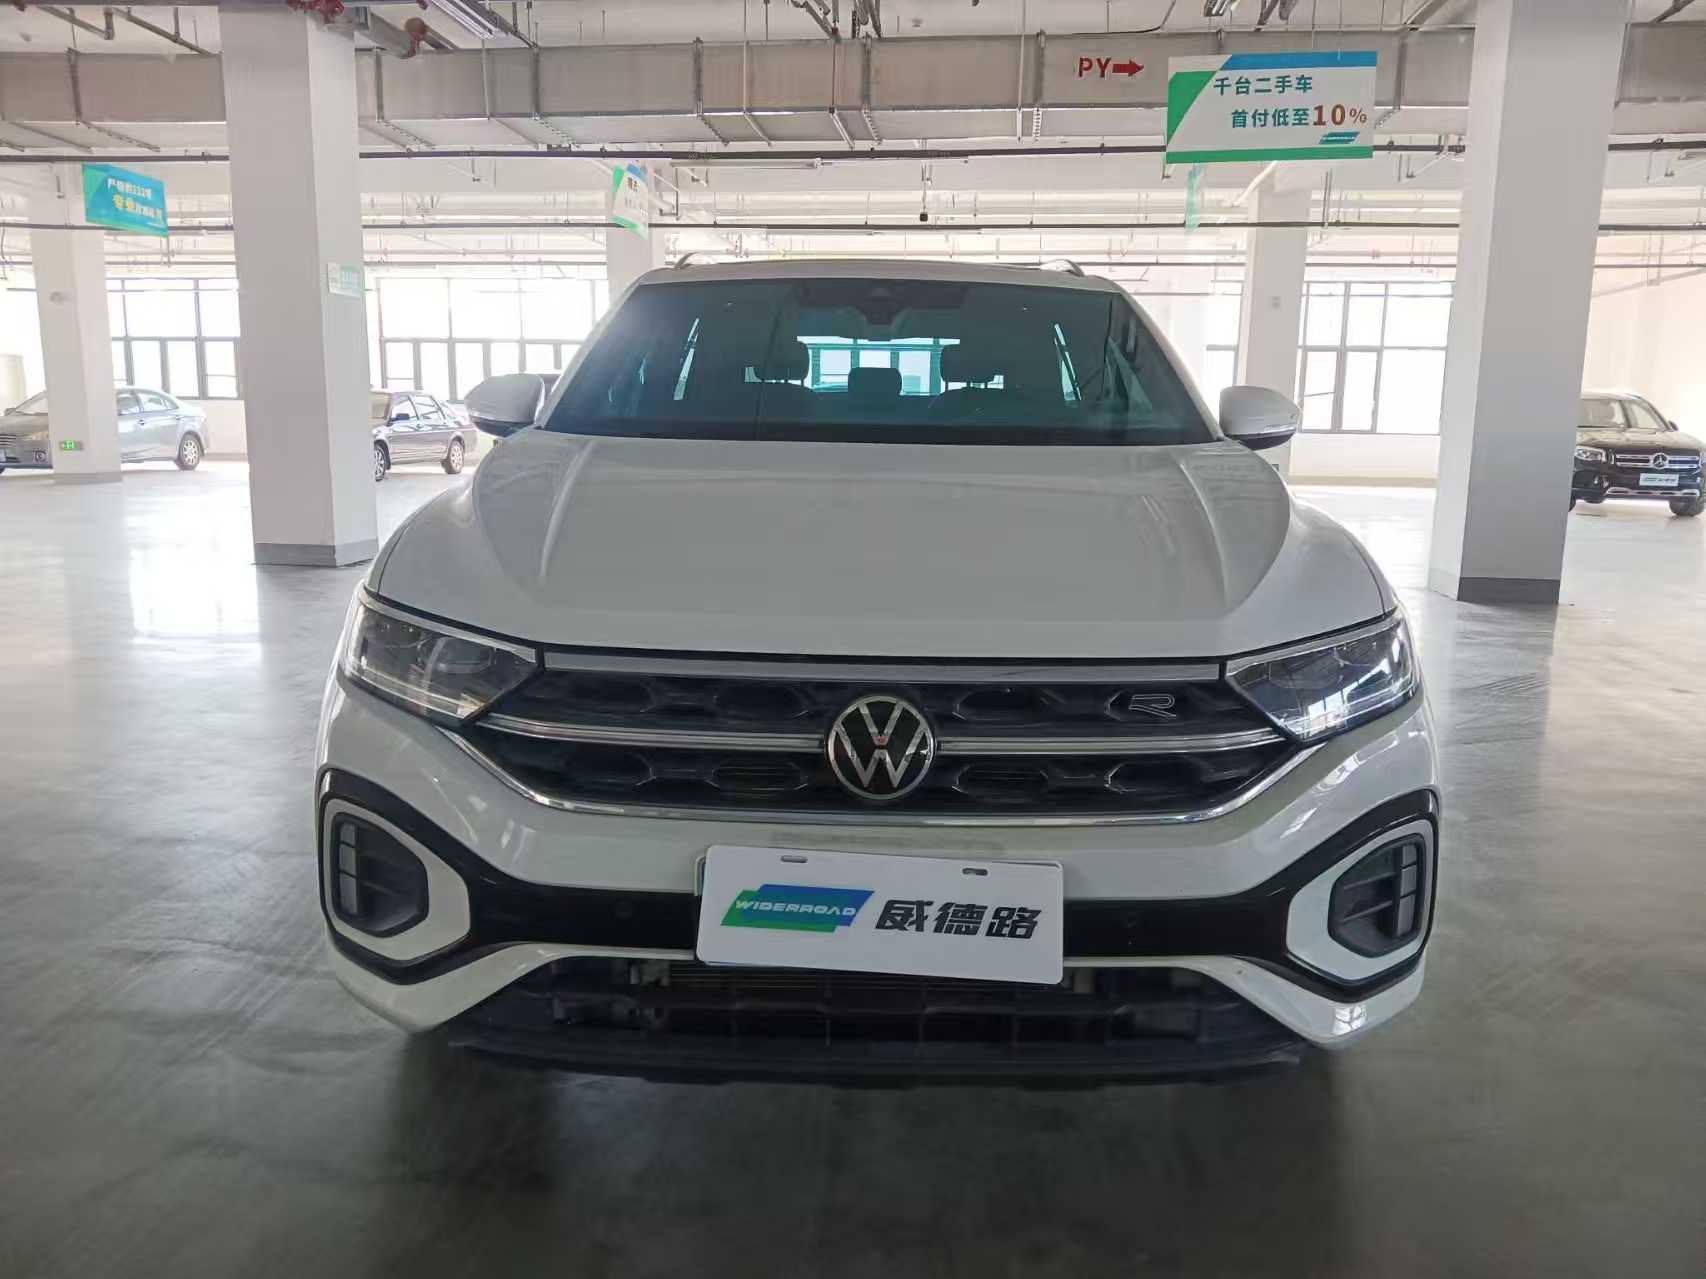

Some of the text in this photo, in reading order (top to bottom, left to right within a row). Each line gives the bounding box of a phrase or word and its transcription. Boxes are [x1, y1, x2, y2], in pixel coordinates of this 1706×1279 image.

[1077, 57, 1112, 78] PY
[1213, 75, 1313, 96] 千台二手车
[1230, 103, 1368, 129] 首付低至10%
[735, 899, 857, 917] WIDERROAD
[874, 898, 1043, 940] 威德路
